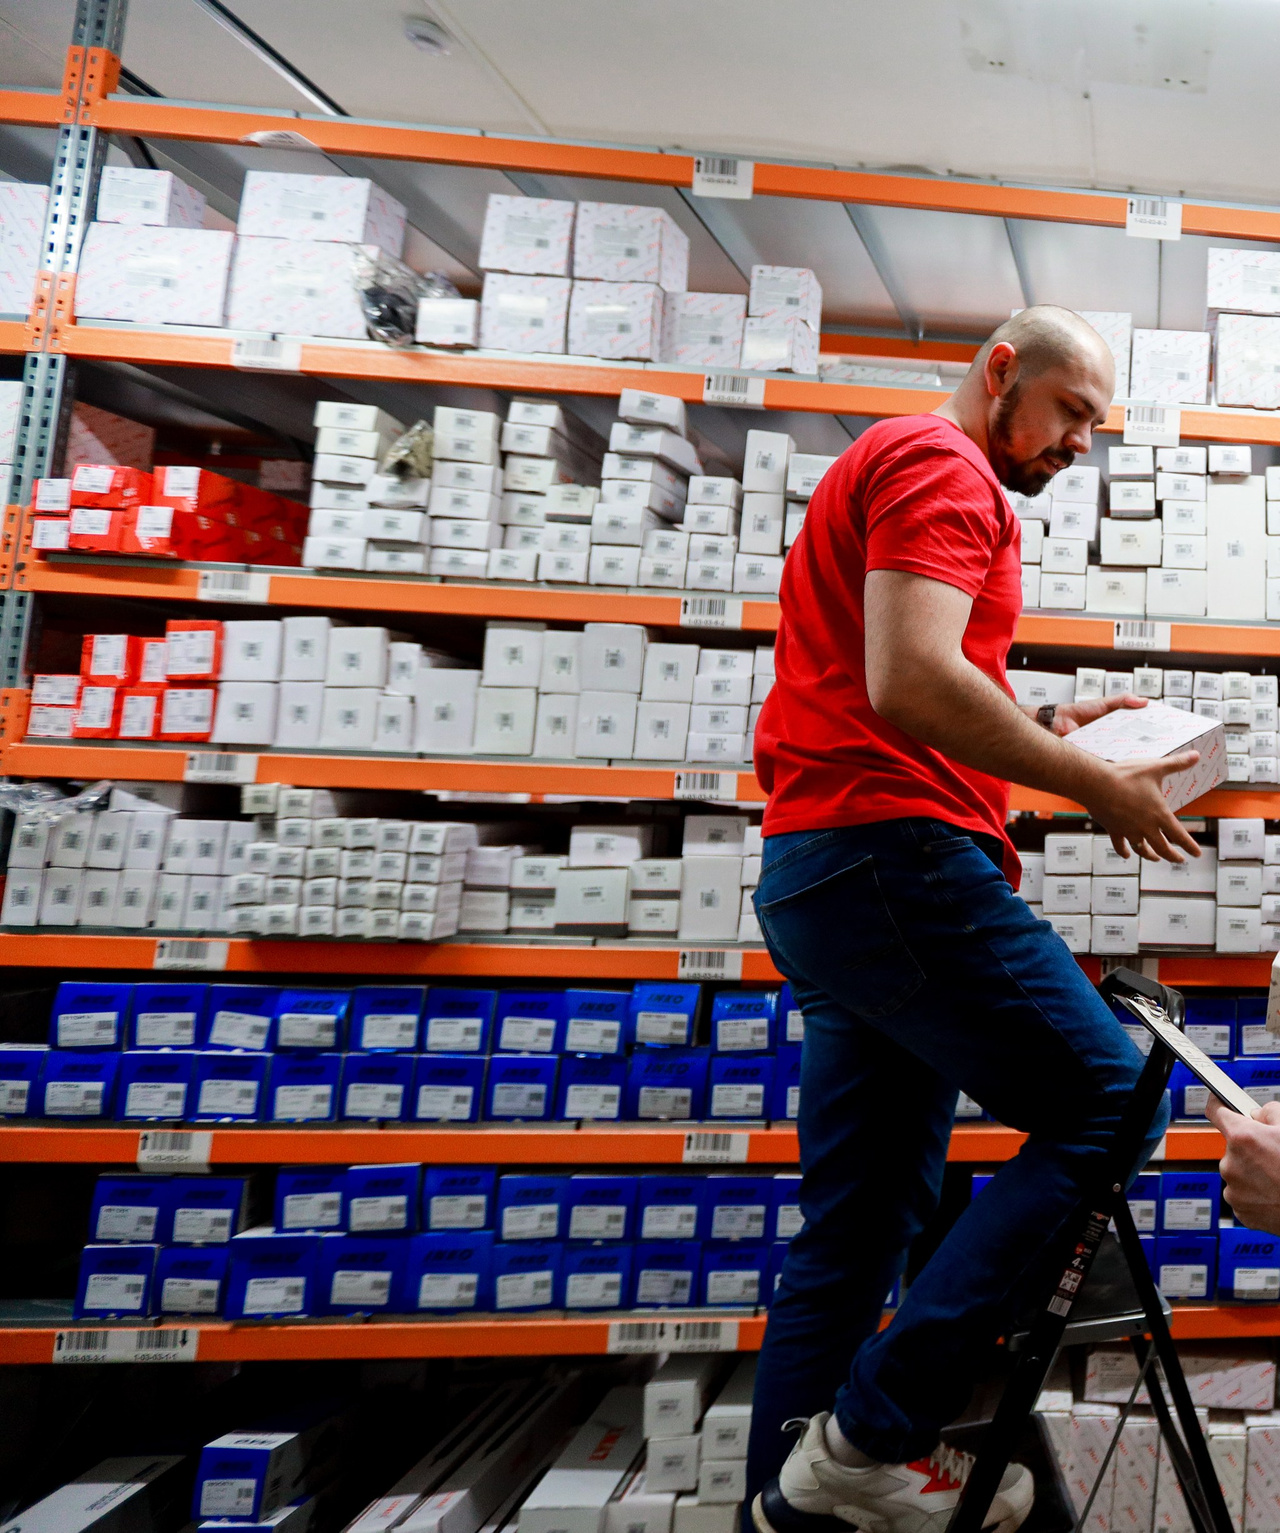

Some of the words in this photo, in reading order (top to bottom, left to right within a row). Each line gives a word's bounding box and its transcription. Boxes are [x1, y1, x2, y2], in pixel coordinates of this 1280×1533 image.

[711, 395, 747, 403] 1-03-03-7-2
[1207, 742, 1220, 759] LYNX
[1186, 779, 1198, 796] LYNX
[647, 993, 684, 1004] INKO
[727, 1002, 765, 1013] INKO
[1233, 1243, 1275, 1255] INKO
